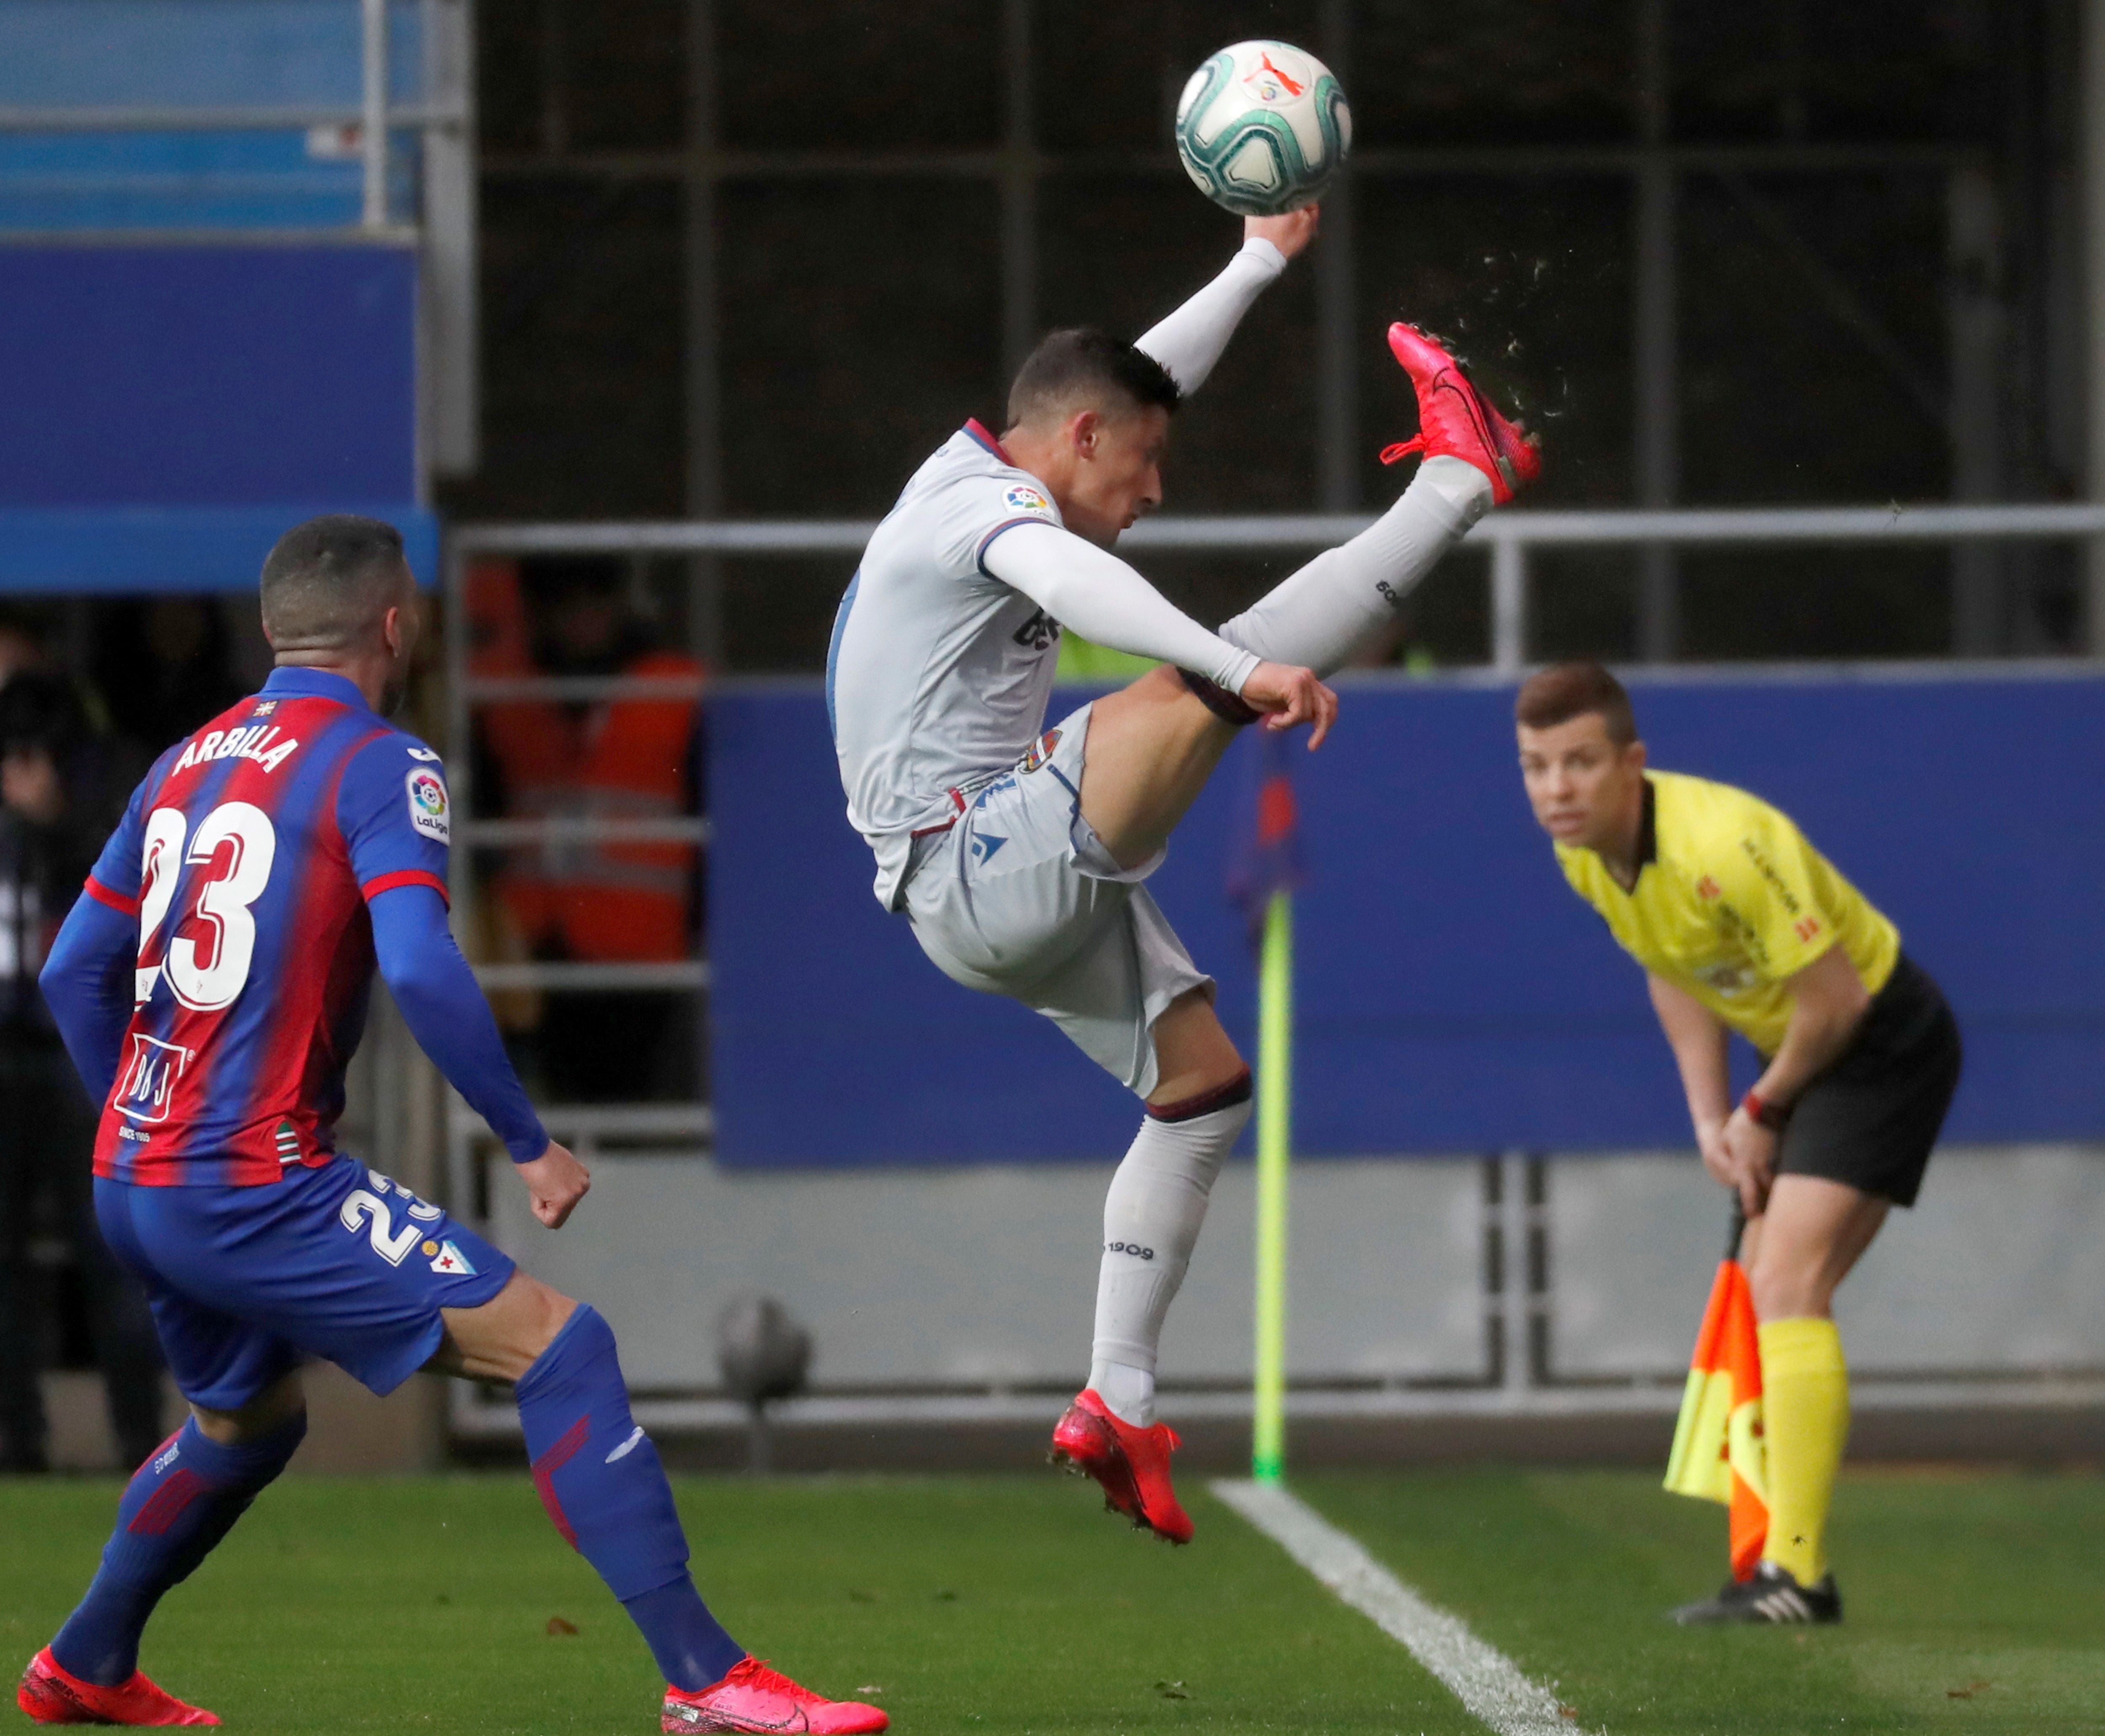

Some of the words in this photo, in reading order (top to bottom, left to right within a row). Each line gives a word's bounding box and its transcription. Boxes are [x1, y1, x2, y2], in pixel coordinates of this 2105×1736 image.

[172, 725, 298, 777] ARBILLA
[417, 815, 448, 834] LaLiga
[134, 801, 276, 1012] 23
[1109, 1242, 1154, 1260] 1909
